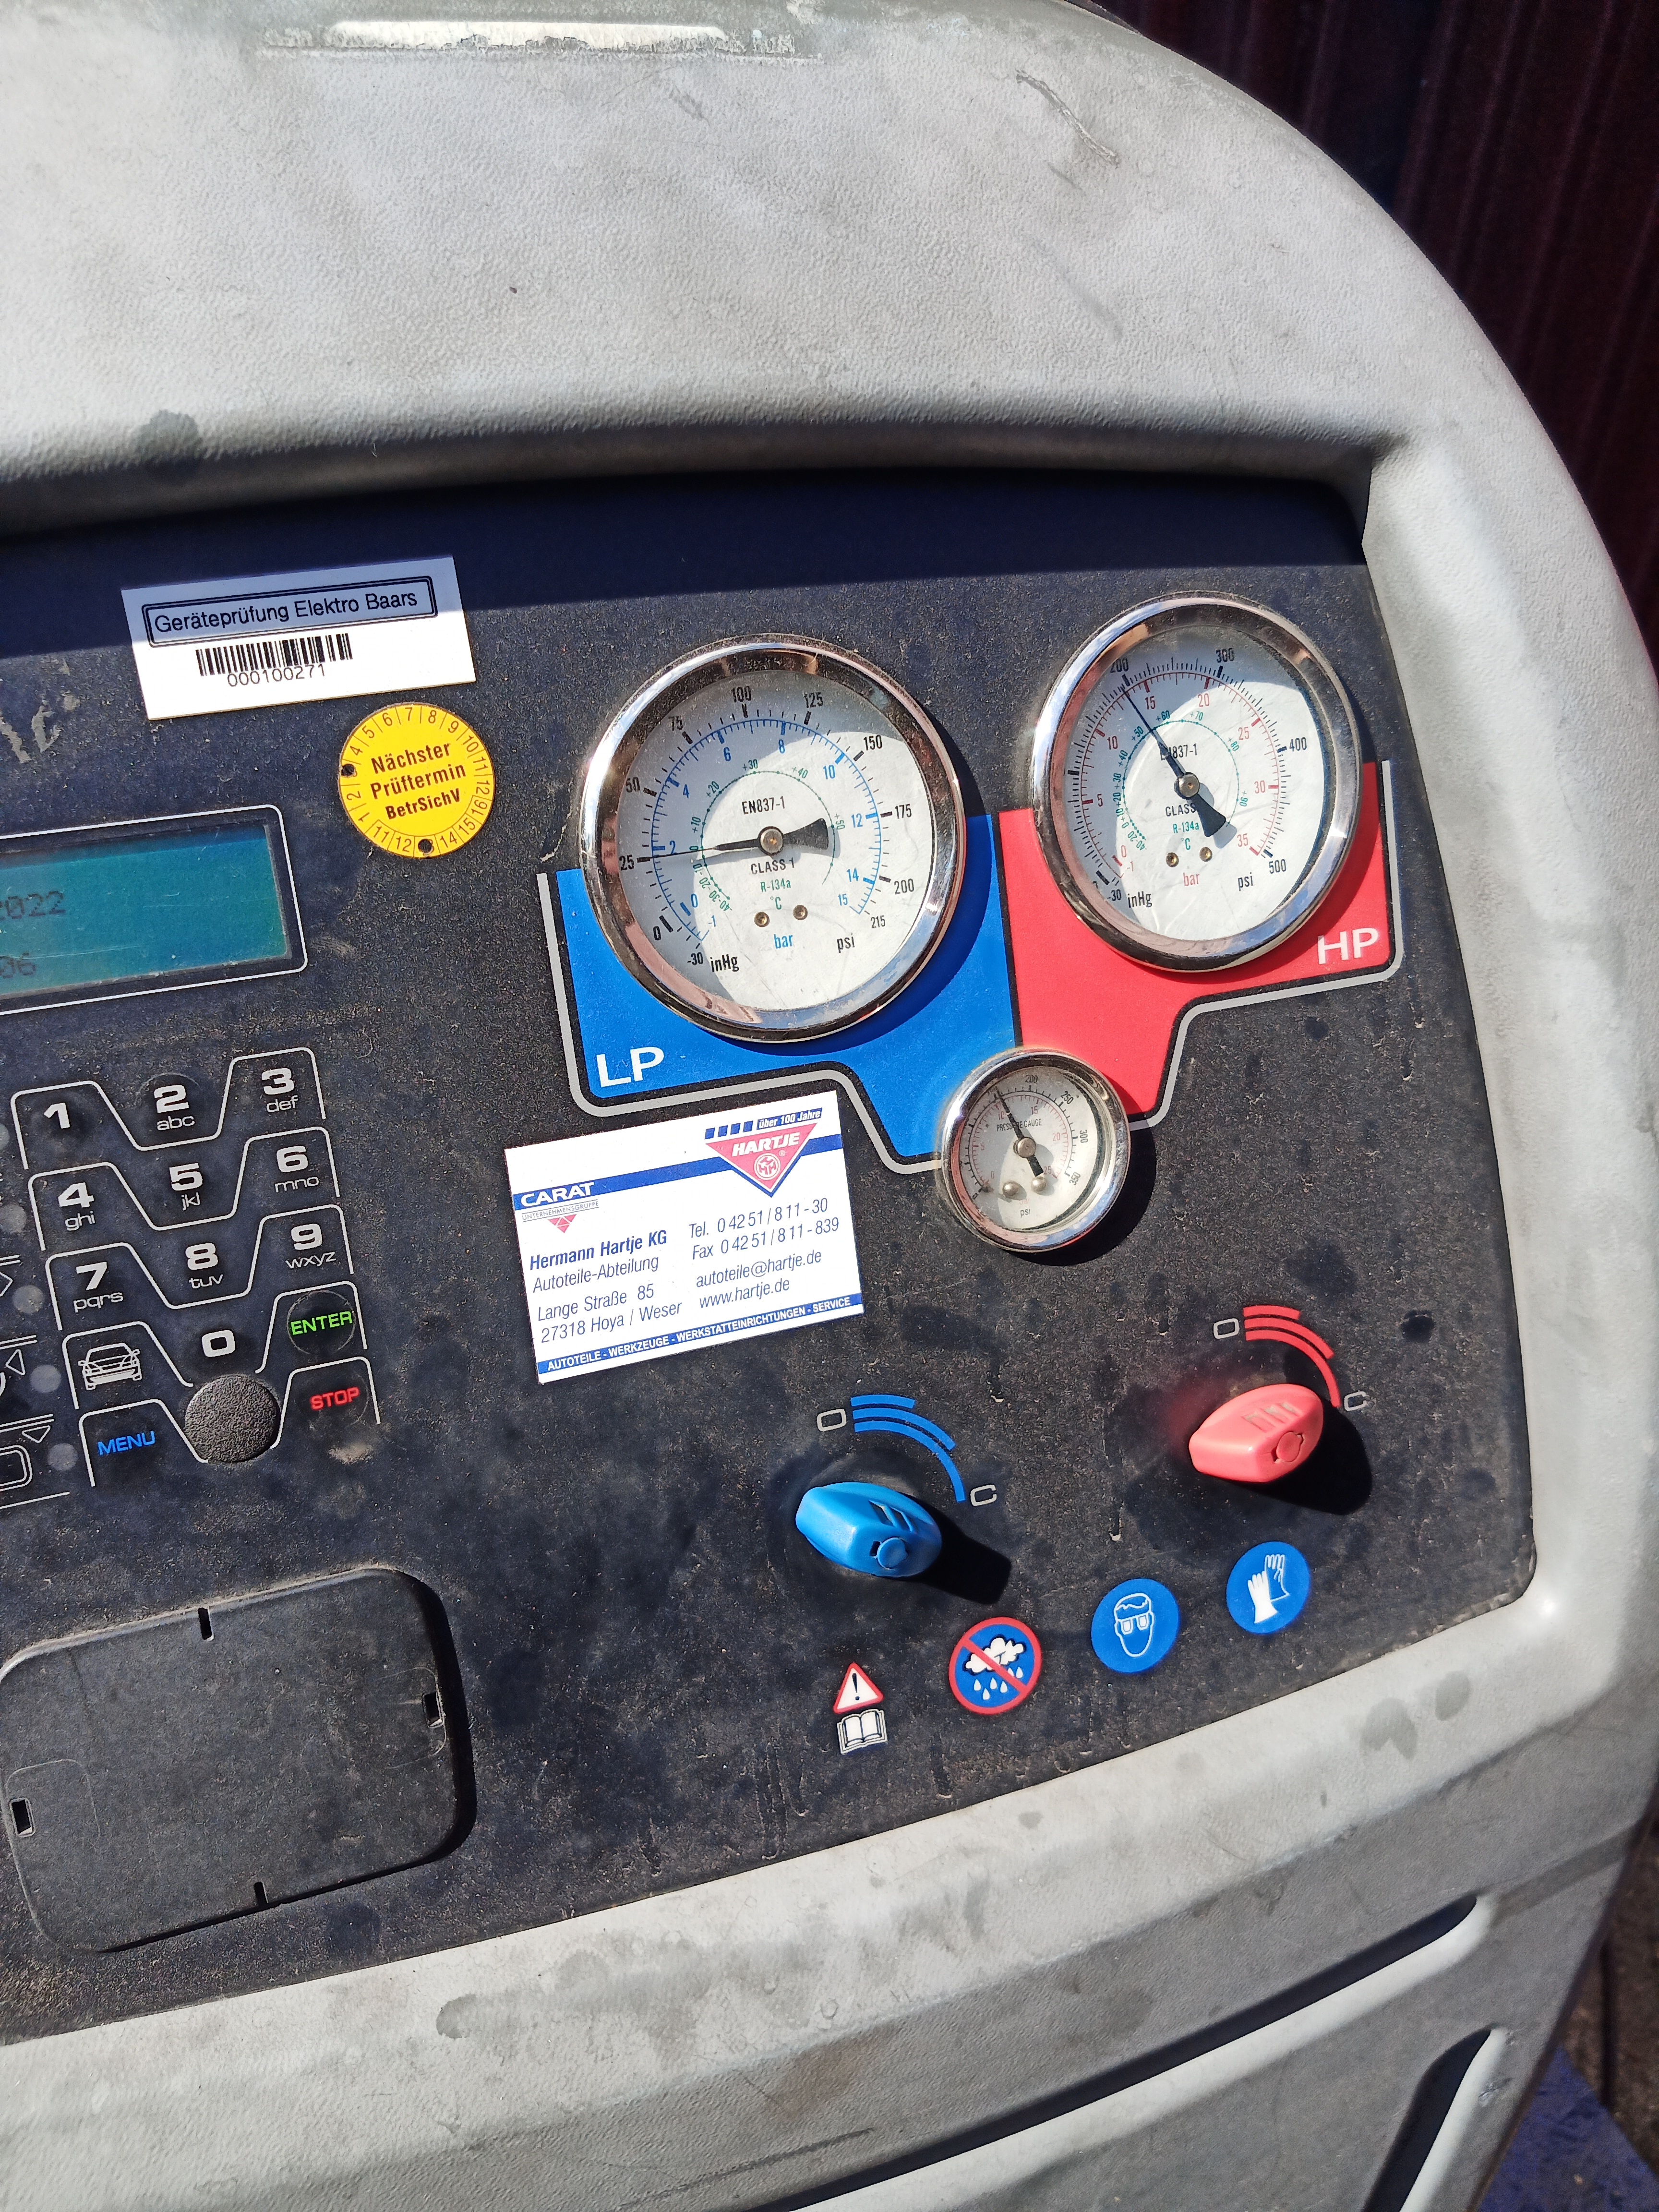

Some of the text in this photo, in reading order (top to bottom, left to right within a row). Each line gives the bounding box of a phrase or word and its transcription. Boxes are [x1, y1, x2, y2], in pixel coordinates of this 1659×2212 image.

[155, 592, 417, 633] Geräteprüfung Elektro Baars
[1216, 648, 1235, 663] 300
[228, 664, 325, 687] 000100271
[732, 686, 751, 702] 100
[803, 692, 823, 709] 125
[1198, 693, 1210, 708] 20
[1144, 696, 1155, 709] 15
[383, 712, 393, 726] 6
[405, 708, 413, 721] 7
[428, 710, 436, 723] 8
[1156, 710, 1170, 721] +60
[362, 725, 374, 739] 5
[448, 721, 459, 733] 9
[1238, 727, 1250, 740] 25
[350, 745, 362, 756] 4
[463, 736, 479, 752] 10
[779, 740, 785, 754] 8
[864, 734, 883, 751] 150
[1107, 735, 1118, 750] 10
[1289, 737, 1307, 752] 400
[371, 743, 451, 774] Nächster
[723, 747, 731, 761] 6
[473, 757, 488, 771] 11
[743, 759, 758, 770] +30
[823, 765, 835, 780] 10
[370, 764, 466, 799] Prüftermin
[476, 780, 490, 794] 12
[626, 778, 640, 793] 50
[1254, 780, 1265, 794] 30
[347, 791, 361, 800] 2
[683, 784, 689, 798] 4
[385, 788, 460, 819] BetrSichV
[742, 796, 786, 815] EN837-1
[1097, 793, 1103, 807] 5
[895, 804, 912, 819] 175
[1166, 803, 1196, 817] CLASS
[458, 817, 476, 835] 15
[852, 814, 863, 828] 12
[1173, 821, 1199, 833] R-134a
[373, 826, 389, 843] 11
[440, 831, 457, 848] 14
[1237, 833, 1248, 847] 35
[396, 836, 412, 852] 12
[1121, 845, 1127, 858] 0
[619, 855, 635, 870] 25
[750, 858, 795, 875] CLASS 1
[1269, 859, 1286, 874] 500
[847, 867, 859, 882] 14
[1183, 872, 1200, 887] bar
[1238, 872, 1253, 891] psi
[760, 878, 791, 892] R-134a
[894, 879, 914, 894] 200
[691, 894, 698, 908] 0
[838, 894, 848, 906] 15
[1107, 889, 1122, 902] -30
[1128, 891, 1152, 908] inHg
[871, 915, 886, 929] 215
[653, 926, 661, 940] 0
[774, 934, 793, 950] bar
[837, 933, 855, 953] psi
[1317, 927, 1379, 964] HP
[687, 952, 703, 965] -30
[711, 954, 739, 972] inHg
[596, 1046, 664, 1088] LP
[261, 1068, 295, 1095] 3
[154, 1084, 188, 1114] 2
[266, 1094, 299, 1113] def
[1060, 1091, 1074, 1105] 250
[44, 1103, 71, 1129] 1
[1031, 1106, 1038, 1115] 15
[156, 1114, 195, 1131] abc
[758, 1109, 821, 1130] über 100 Jahre
[1024, 1118, 1042, 1128] GAUGE
[732, 1132, 801, 1157] HARTJE
[1052, 1132, 1060, 1142] 20
[1080, 1130, 1088, 1143] 300
[276, 1145, 309, 1173] 6
[170, 1163, 203, 1191] 5
[275, 1175, 319, 1193] mno
[1069, 1171, 1081, 1186] 350
[58, 1183, 94, 1209] 4
[181, 1192, 201, 1210] jkl
[520, 1182, 595, 1207] CARAT
[522, 1201, 599, 1221] UNTERNEHMENSGRUPPE
[1020, 1208, 1031, 1218] psi
[65, 1211, 95, 1231] ghi
[290, 1223, 323, 1250] 9
[689, 1222, 709, 1238] Tel.
[185, 1243, 218, 1270] 8
[530, 1230, 667, 1271] Hermann Hartje KG
[693, 1245, 714, 1260] Fax
[286, 1251, 337, 1270] wxyz
[696, 1250, 822, 1287] autoteile@hartje.de
[76, 1263, 109, 1291] 7
[189, 1274, 224, 1289] tuv
[532, 1256, 659, 1293] Autoteile-Abteilung
[699, 1278, 790, 1309] www.hartje.de
[73, 1291, 124, 1313] pqrs
[538, 1283, 654, 1322] Lange Straße 85
[290, 1311, 353, 1335] ENTER
[541, 1302, 682, 1343] 27318 Hoya Weser
[547, 1297, 851, 1371] AUTOTEILE WERKZEUGE WERKSTATTEINRICHTUNGEN SERVICE
[202, 1330, 236, 1357] 0
[310, 1386, 360, 1410] STOP
[97, 1431, 156, 1456] MENU
